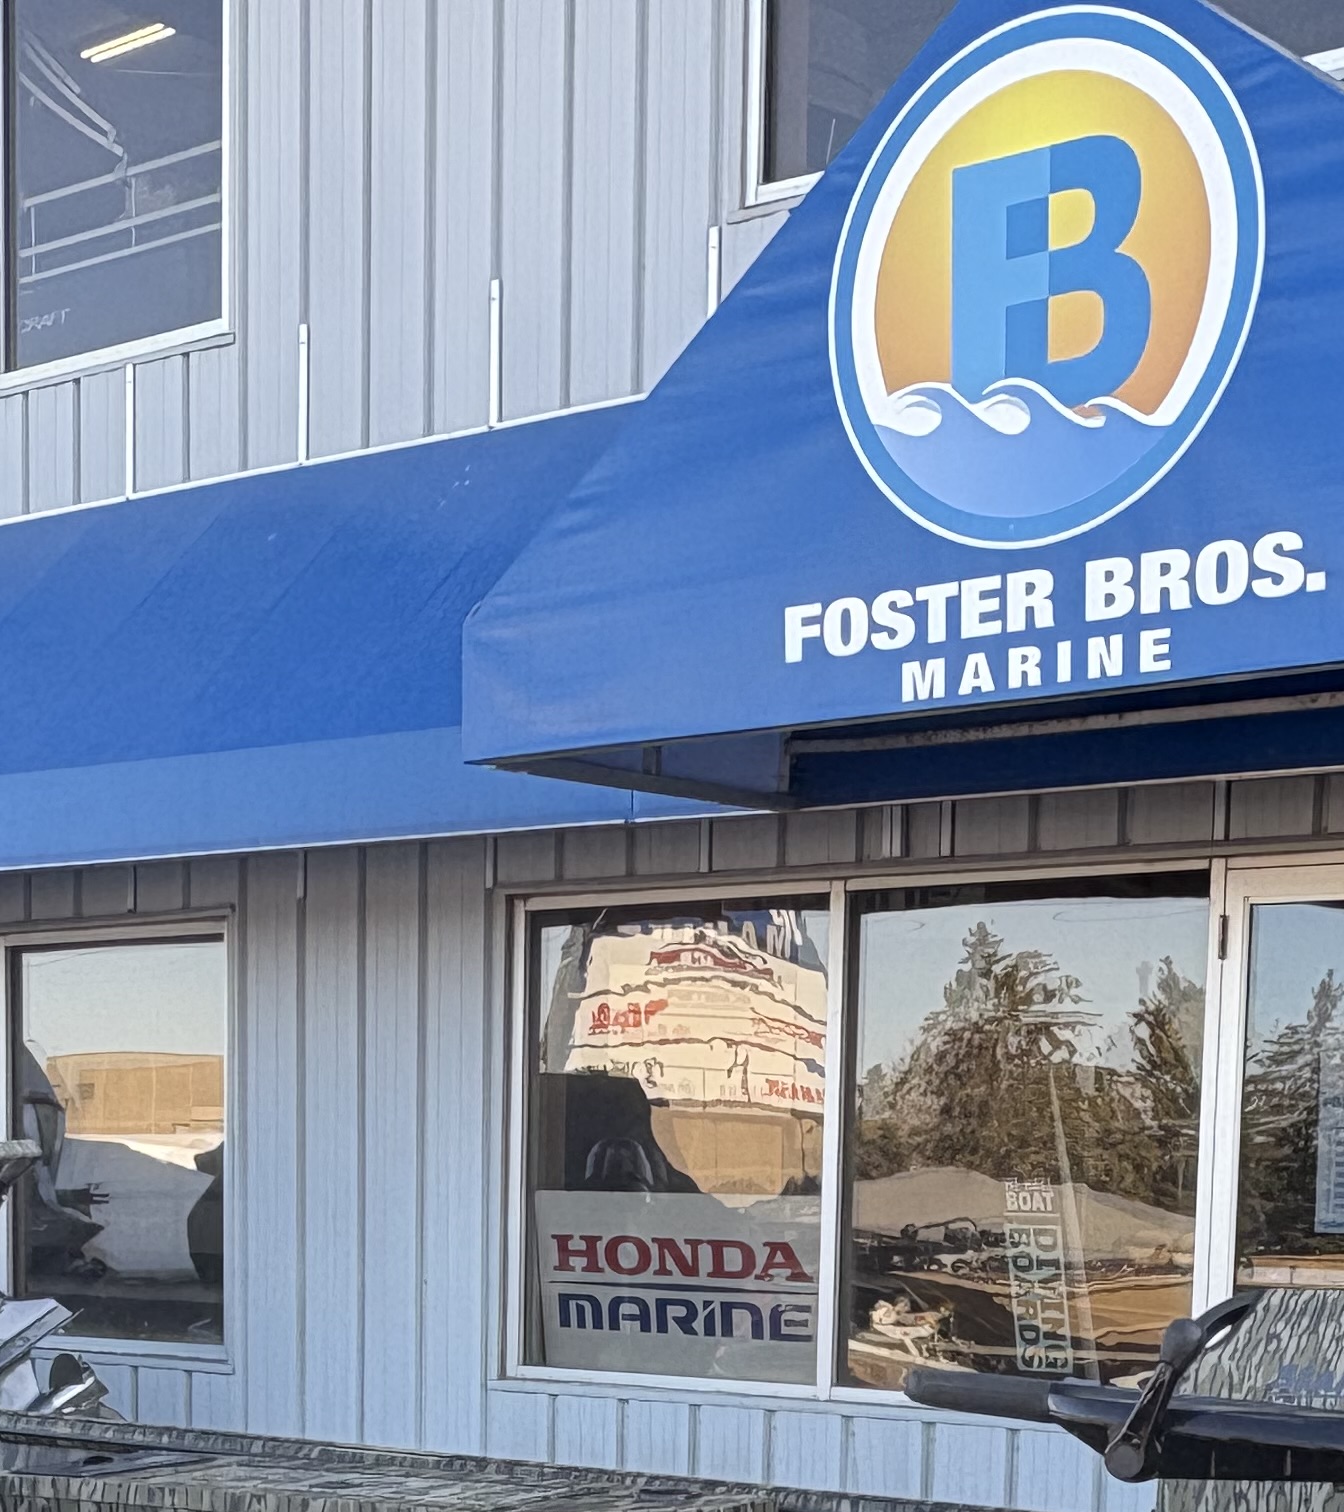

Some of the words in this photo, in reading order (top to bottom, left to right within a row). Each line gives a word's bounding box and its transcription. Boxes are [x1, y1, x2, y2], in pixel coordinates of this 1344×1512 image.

[784, 568, 1055, 663] FOSTER
[1084, 531, 1326, 622] BROS.
[901, 627, 1172, 703] MARINE
[1006, 1191, 1055, 1212] BOAT
[551, 1234, 815, 1283] HONDA
[558, 1293, 815, 1342] MARINE
